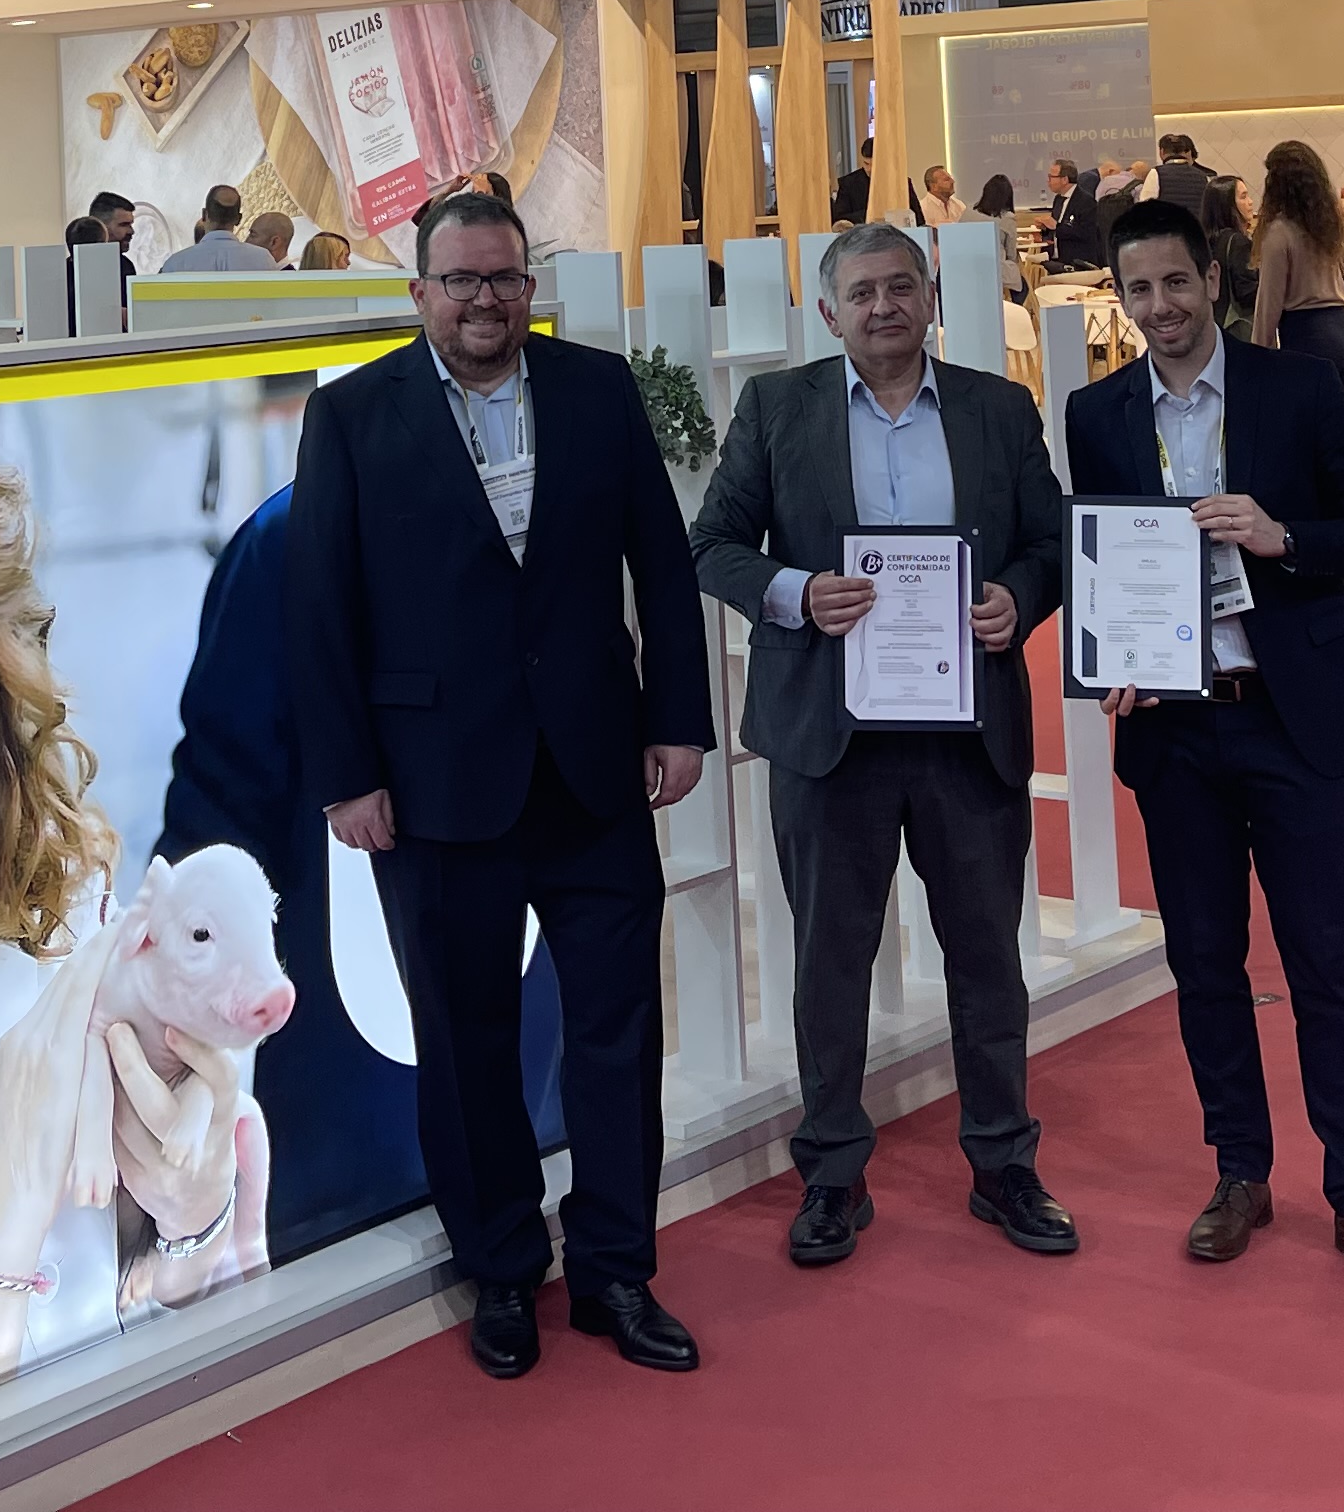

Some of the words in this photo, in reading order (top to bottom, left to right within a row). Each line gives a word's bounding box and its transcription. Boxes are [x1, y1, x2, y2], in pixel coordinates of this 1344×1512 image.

[328, 12, 383, 53] DELIZIAS
[350, 65, 384, 89] JAMÓN
[349, 76, 389, 102] COCIDO
[991, 133, 1029, 146] NOEL,
[1032, 133, 1049, 143] UN
[1052, 129, 1099, 143] GRUPO
[1102, 128, 1118, 140] DE
[1134, 518, 1159, 529] OCA
[887, 554, 938, 562] CERTIFICADO
[887, 563, 951, 571] CONFORMIDAD
[898, 574, 922, 584] OCA
